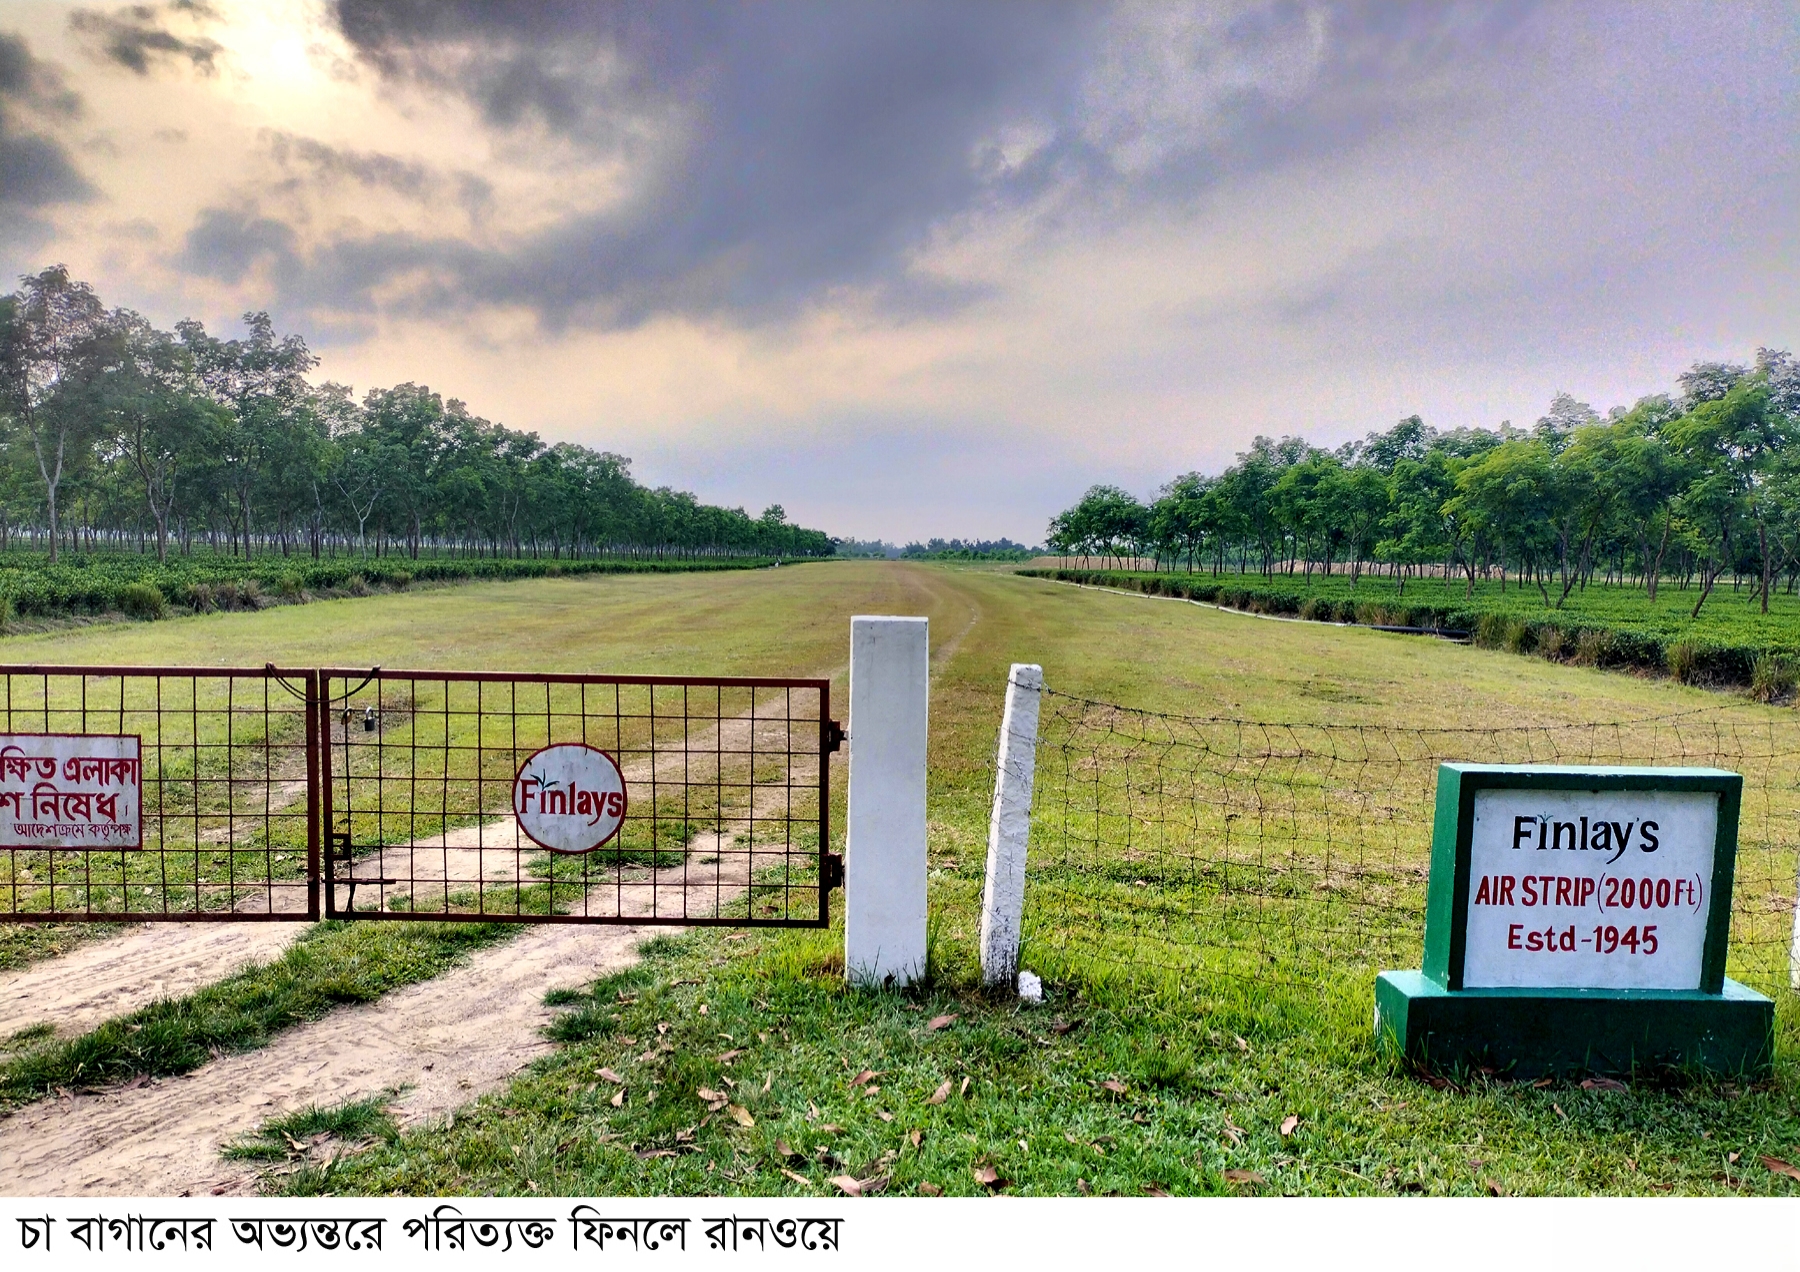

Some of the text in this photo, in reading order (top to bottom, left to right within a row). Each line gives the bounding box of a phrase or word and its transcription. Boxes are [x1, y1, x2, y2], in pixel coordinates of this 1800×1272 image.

[63, 757, 138, 786] এলাকা
[520, 779, 623, 827] Finlays
[14, 823, 85, 839] আদেশক্রমে
[1512, 815, 1660, 864] Finlay's
[1474, 875, 1516, 906] AIR
